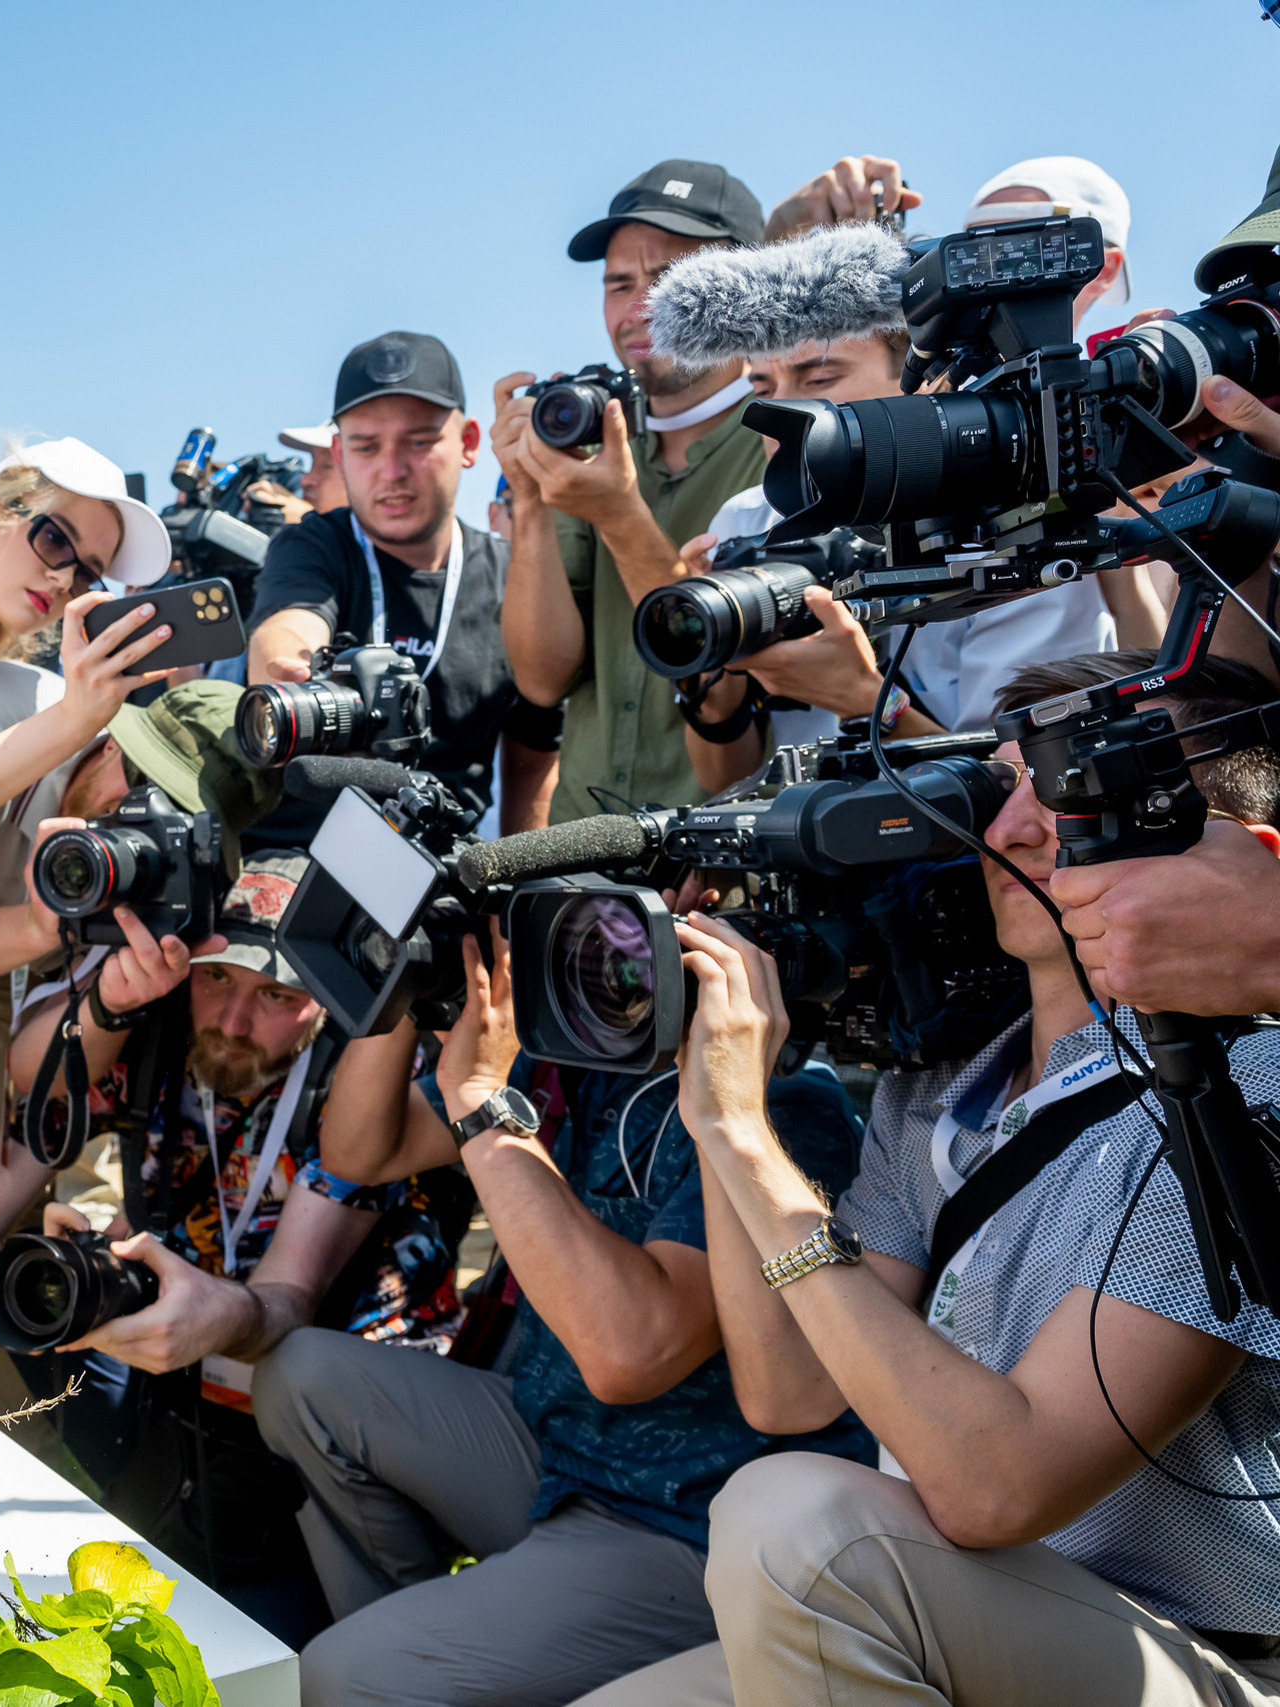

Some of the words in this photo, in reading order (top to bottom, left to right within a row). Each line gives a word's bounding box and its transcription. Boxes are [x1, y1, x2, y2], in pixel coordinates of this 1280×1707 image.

[908, 277, 926, 297] SONY
[1217, 273, 1248, 292] SONY
[393, 636, 435, 657] FILA
[119, 806, 147, 815] Canon
[694, 815, 722, 825] SONY
[1061, 1055, 1113, 1087] ОСАГРО
[934, 1301, 947, 1318] 23
